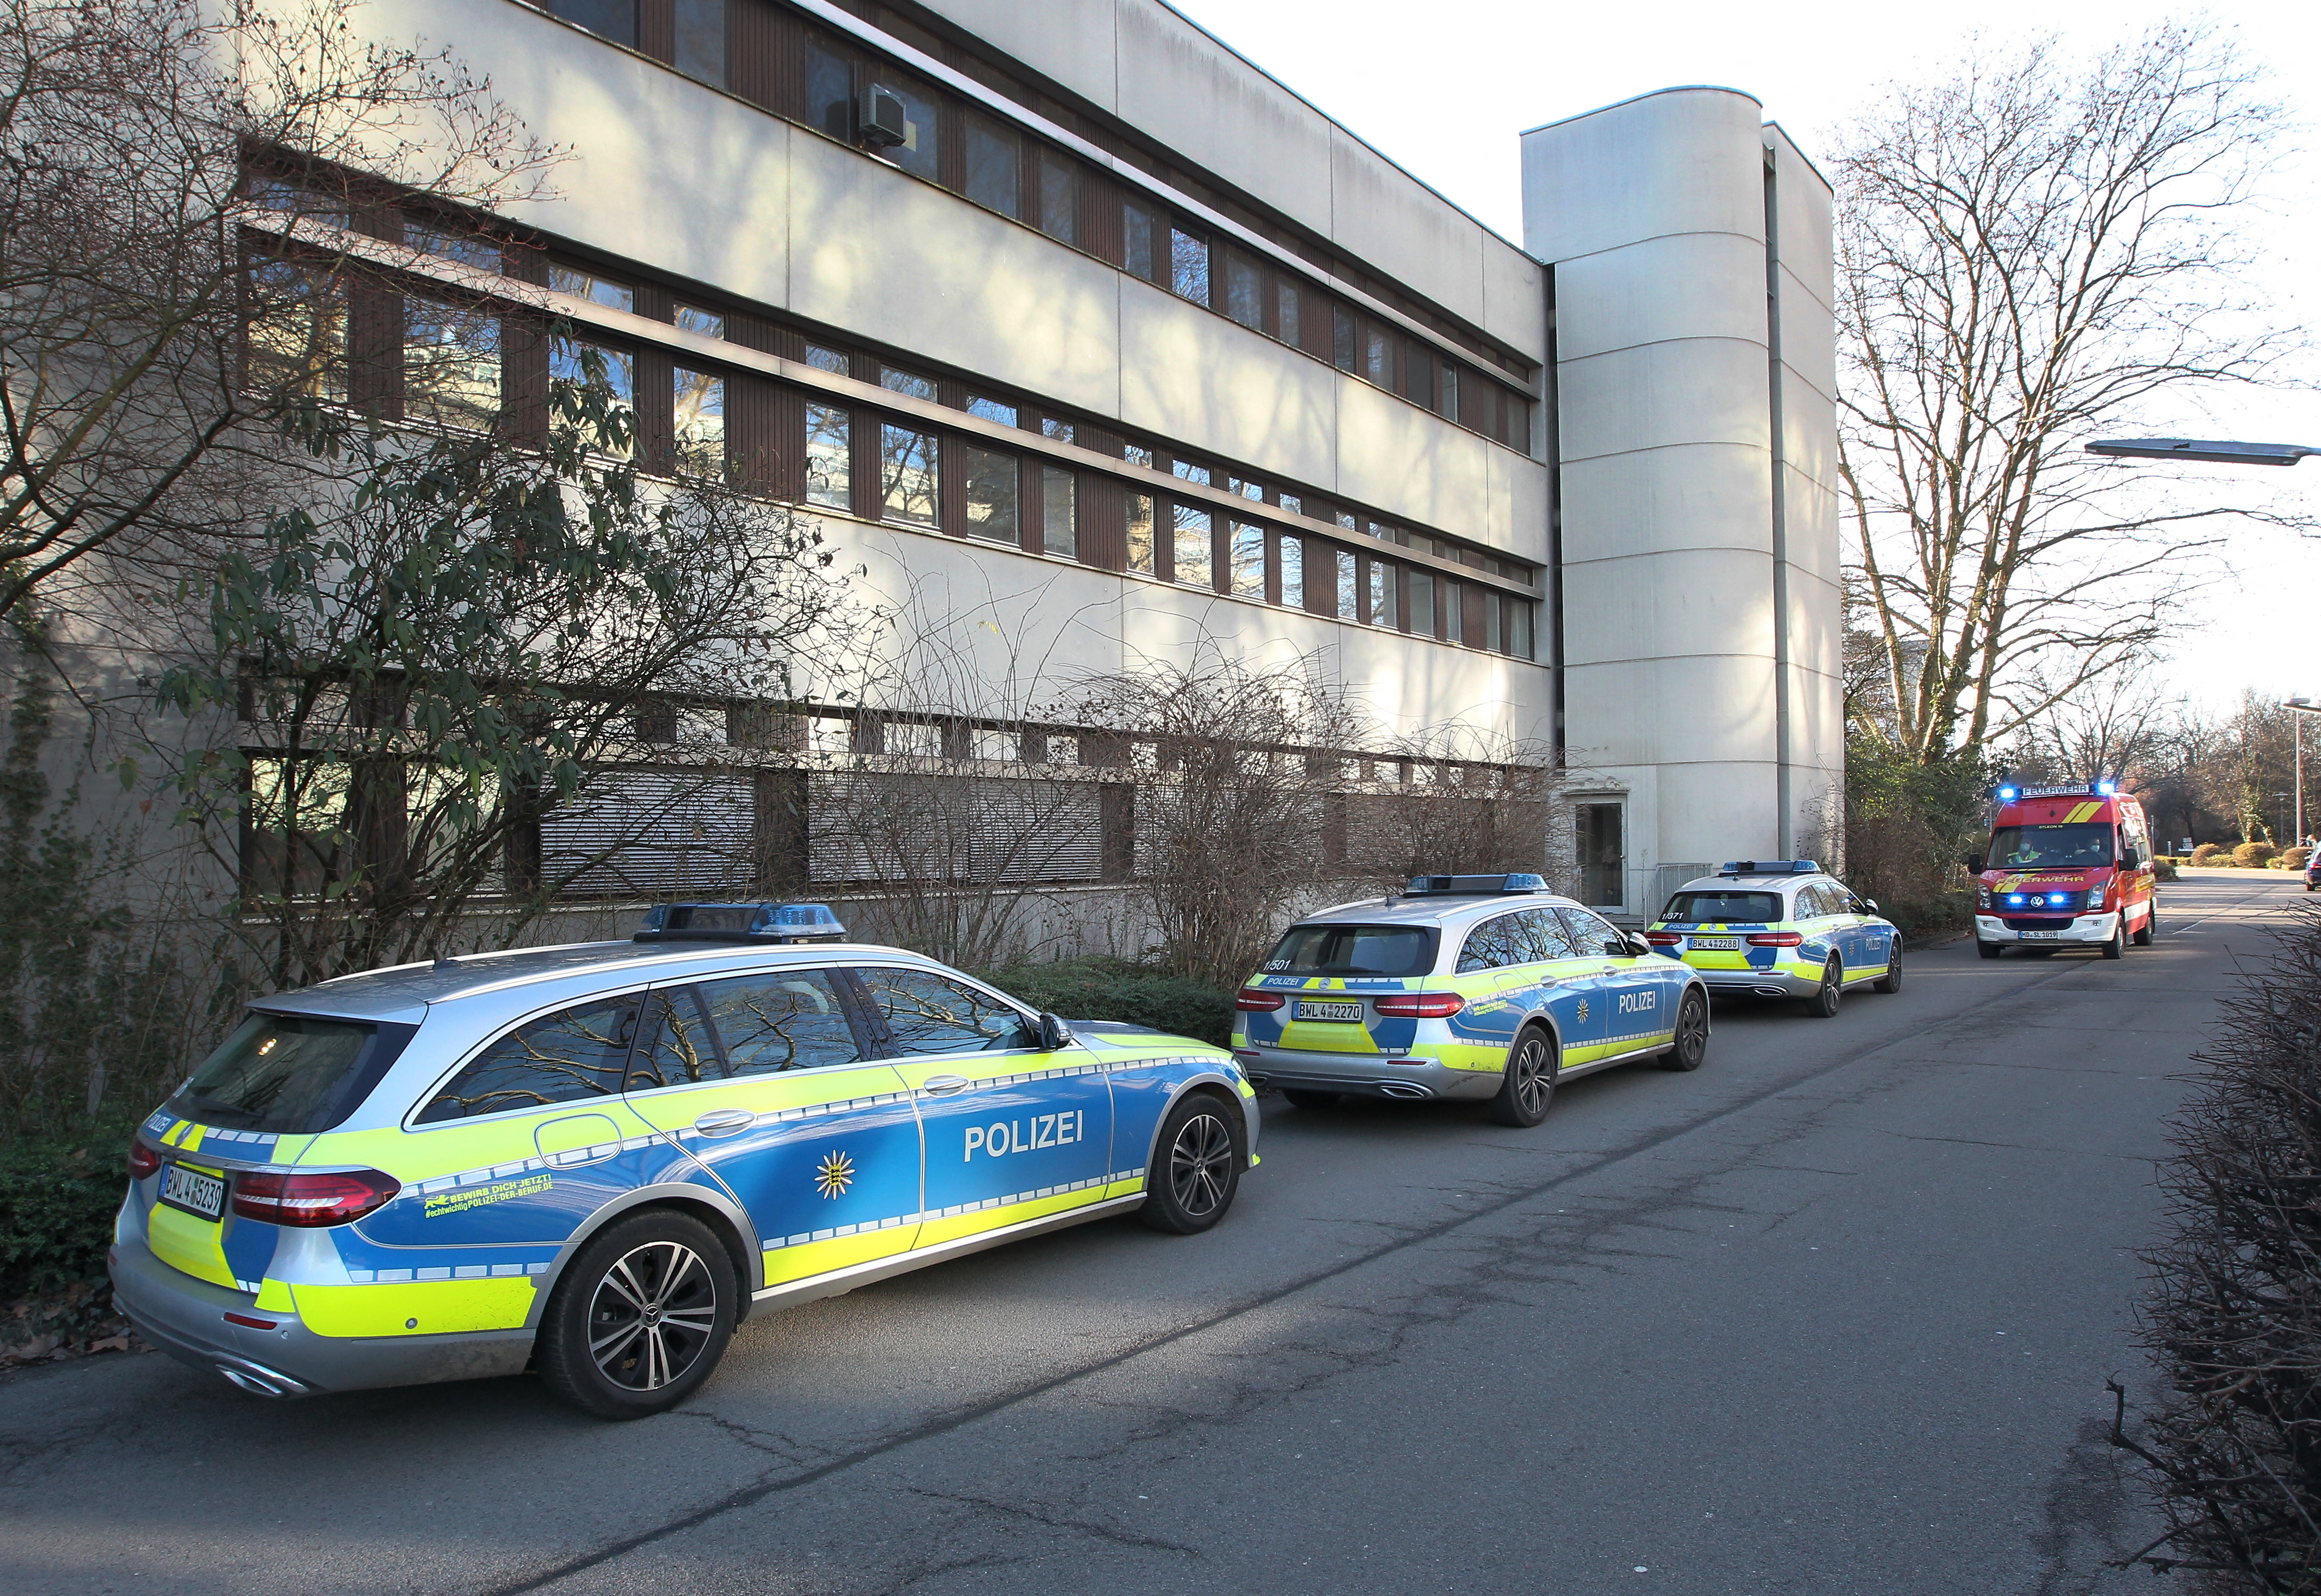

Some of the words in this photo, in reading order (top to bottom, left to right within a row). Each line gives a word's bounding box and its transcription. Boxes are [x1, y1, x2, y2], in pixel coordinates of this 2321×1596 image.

[2024, 785, 2087, 795] FEUERWEHR
[1718, 940, 1737, 948] 2288
[1865, 938, 1882, 951] POLIZEI
[1263, 959, 1291, 971] 1/501
[1267, 978, 1300, 986] POLIZEI
[1618, 990, 1656, 1014] POLIZEI
[1299, 1004, 1318, 1017] BWL
[1334, 1005, 1360, 1019] 2270
[964, 1109, 1083, 1162] POLIZEI
[166, 1169, 182, 1199] BWL
[196, 1179, 221, 1211] 5239
[449, 1188, 490, 1204] BEWIRB
[491, 1181, 517, 1194] DICH
[519, 1173, 552, 1188] JETZT!
